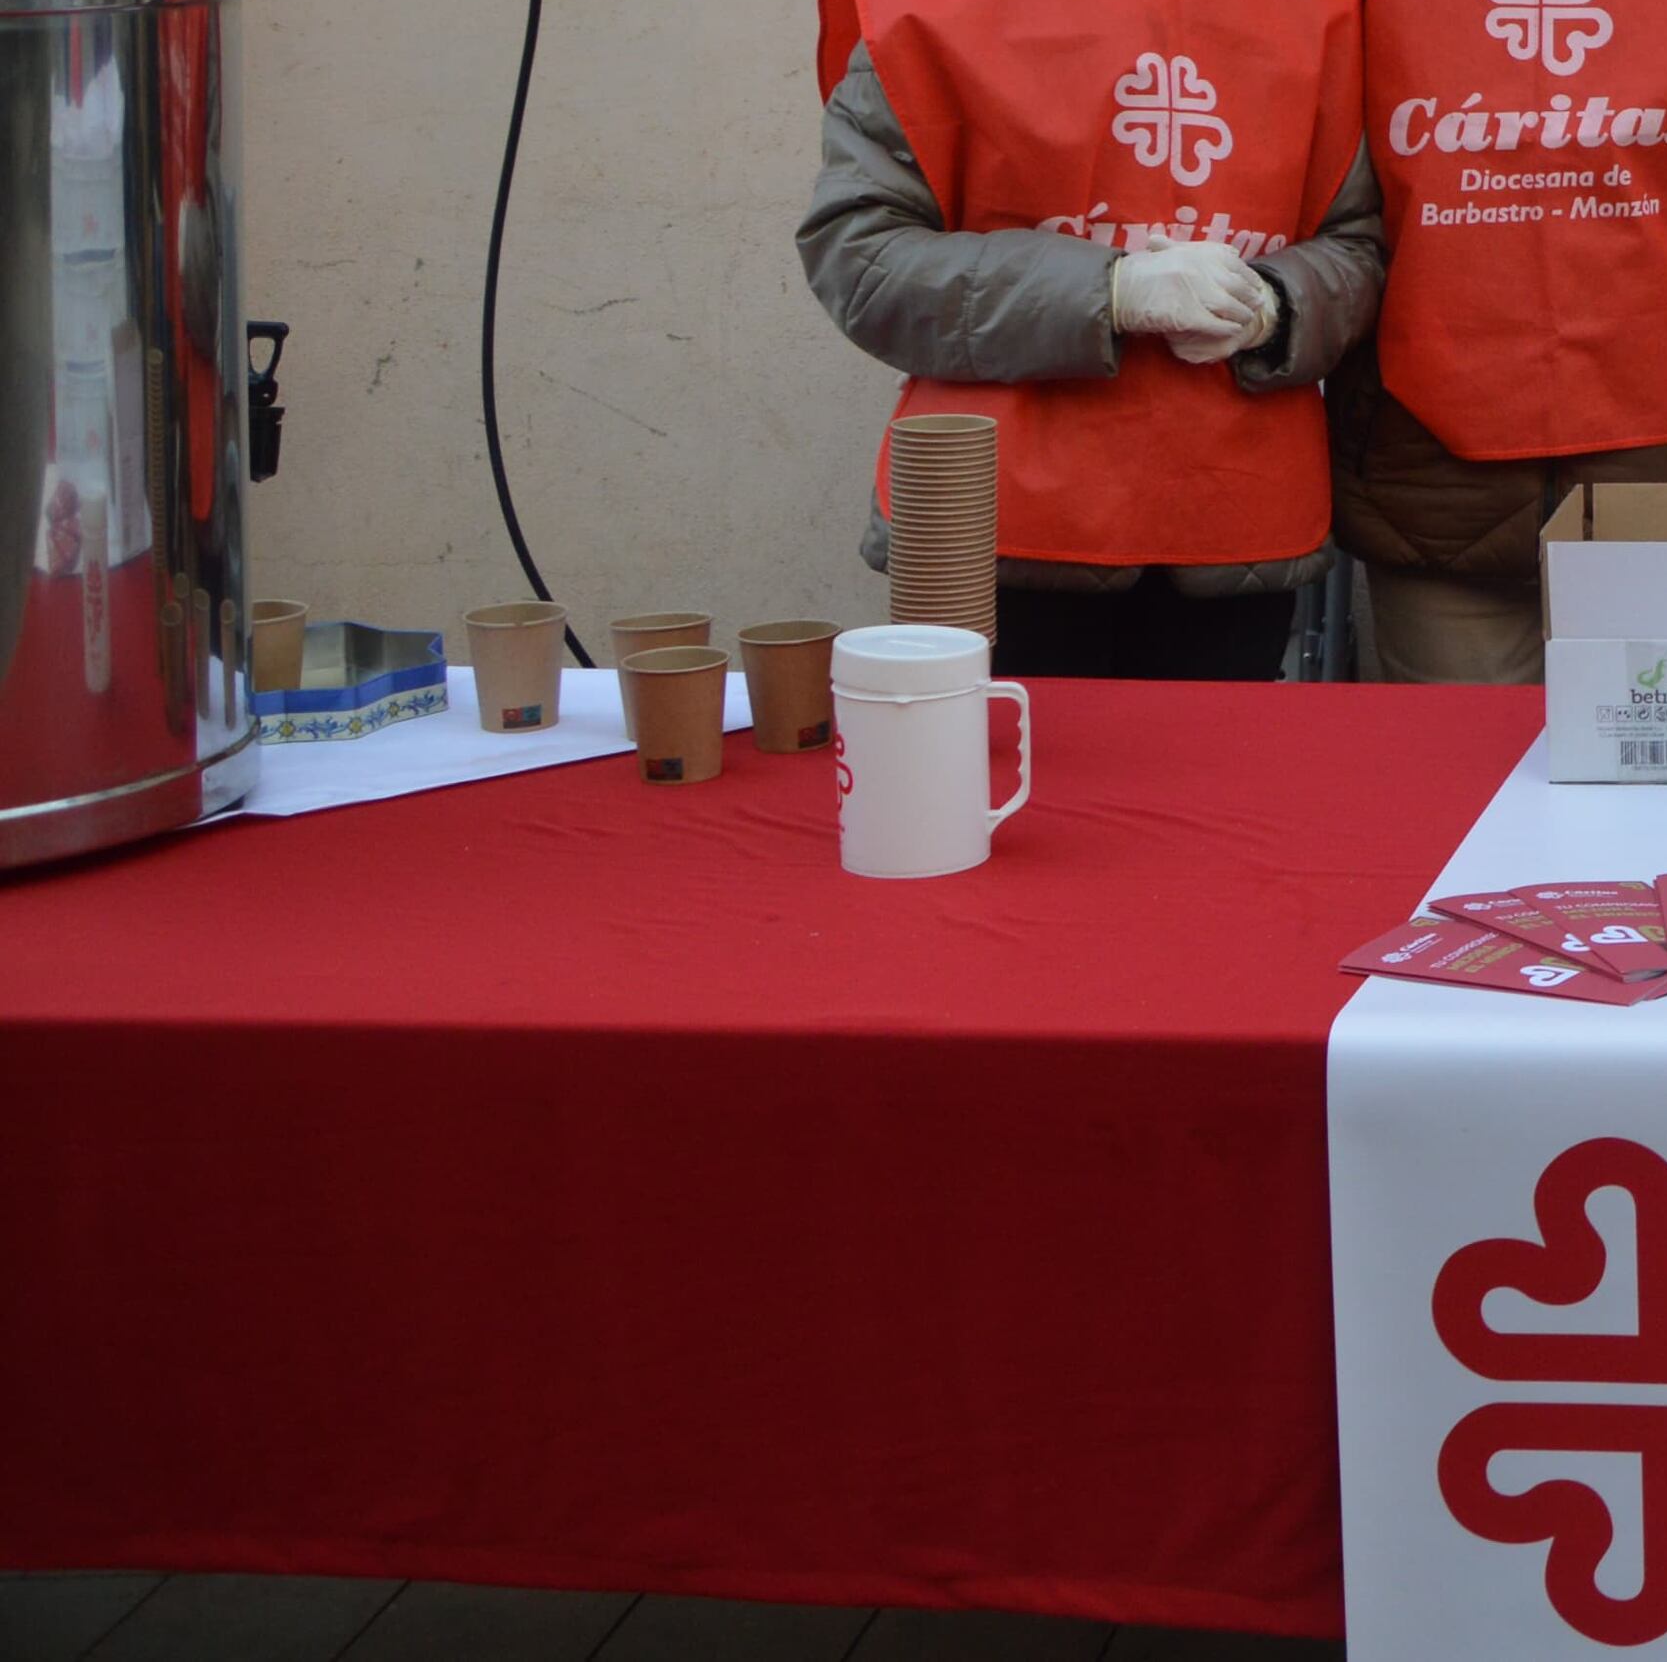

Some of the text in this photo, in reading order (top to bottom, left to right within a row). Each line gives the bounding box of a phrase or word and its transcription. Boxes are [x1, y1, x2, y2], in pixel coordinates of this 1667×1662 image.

[1460, 163, 1632, 192] Diocesana de
[1420, 201, 1544, 227] Barbastro
[1569, 192, 1660, 221] Monzón
